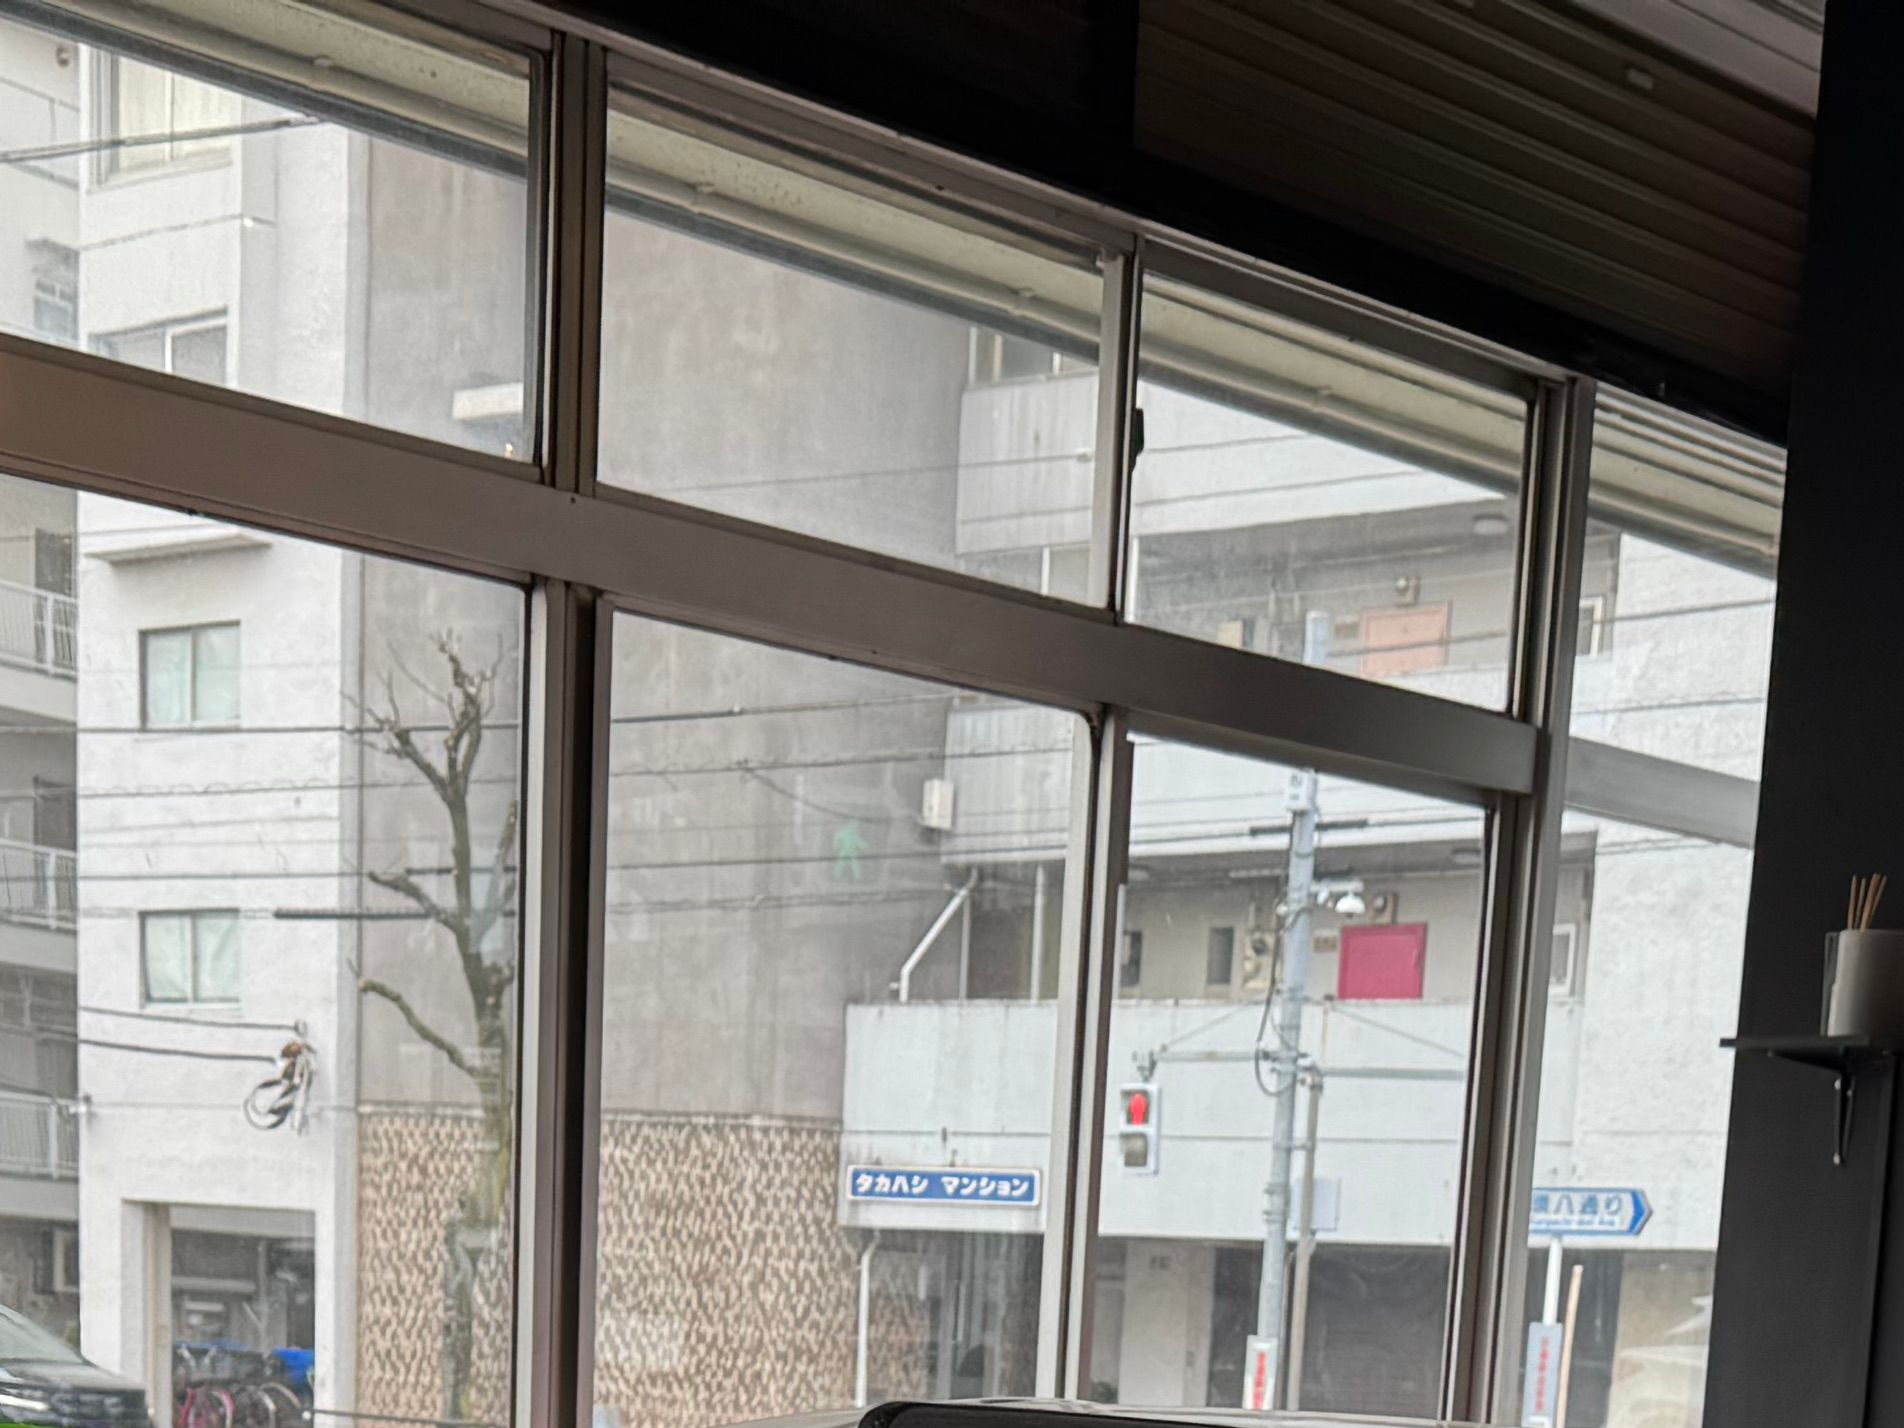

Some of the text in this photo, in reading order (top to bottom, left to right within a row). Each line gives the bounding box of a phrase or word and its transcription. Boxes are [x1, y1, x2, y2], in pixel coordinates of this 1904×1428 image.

[856, 1173, 1030, 1198] タカハシ マンション
